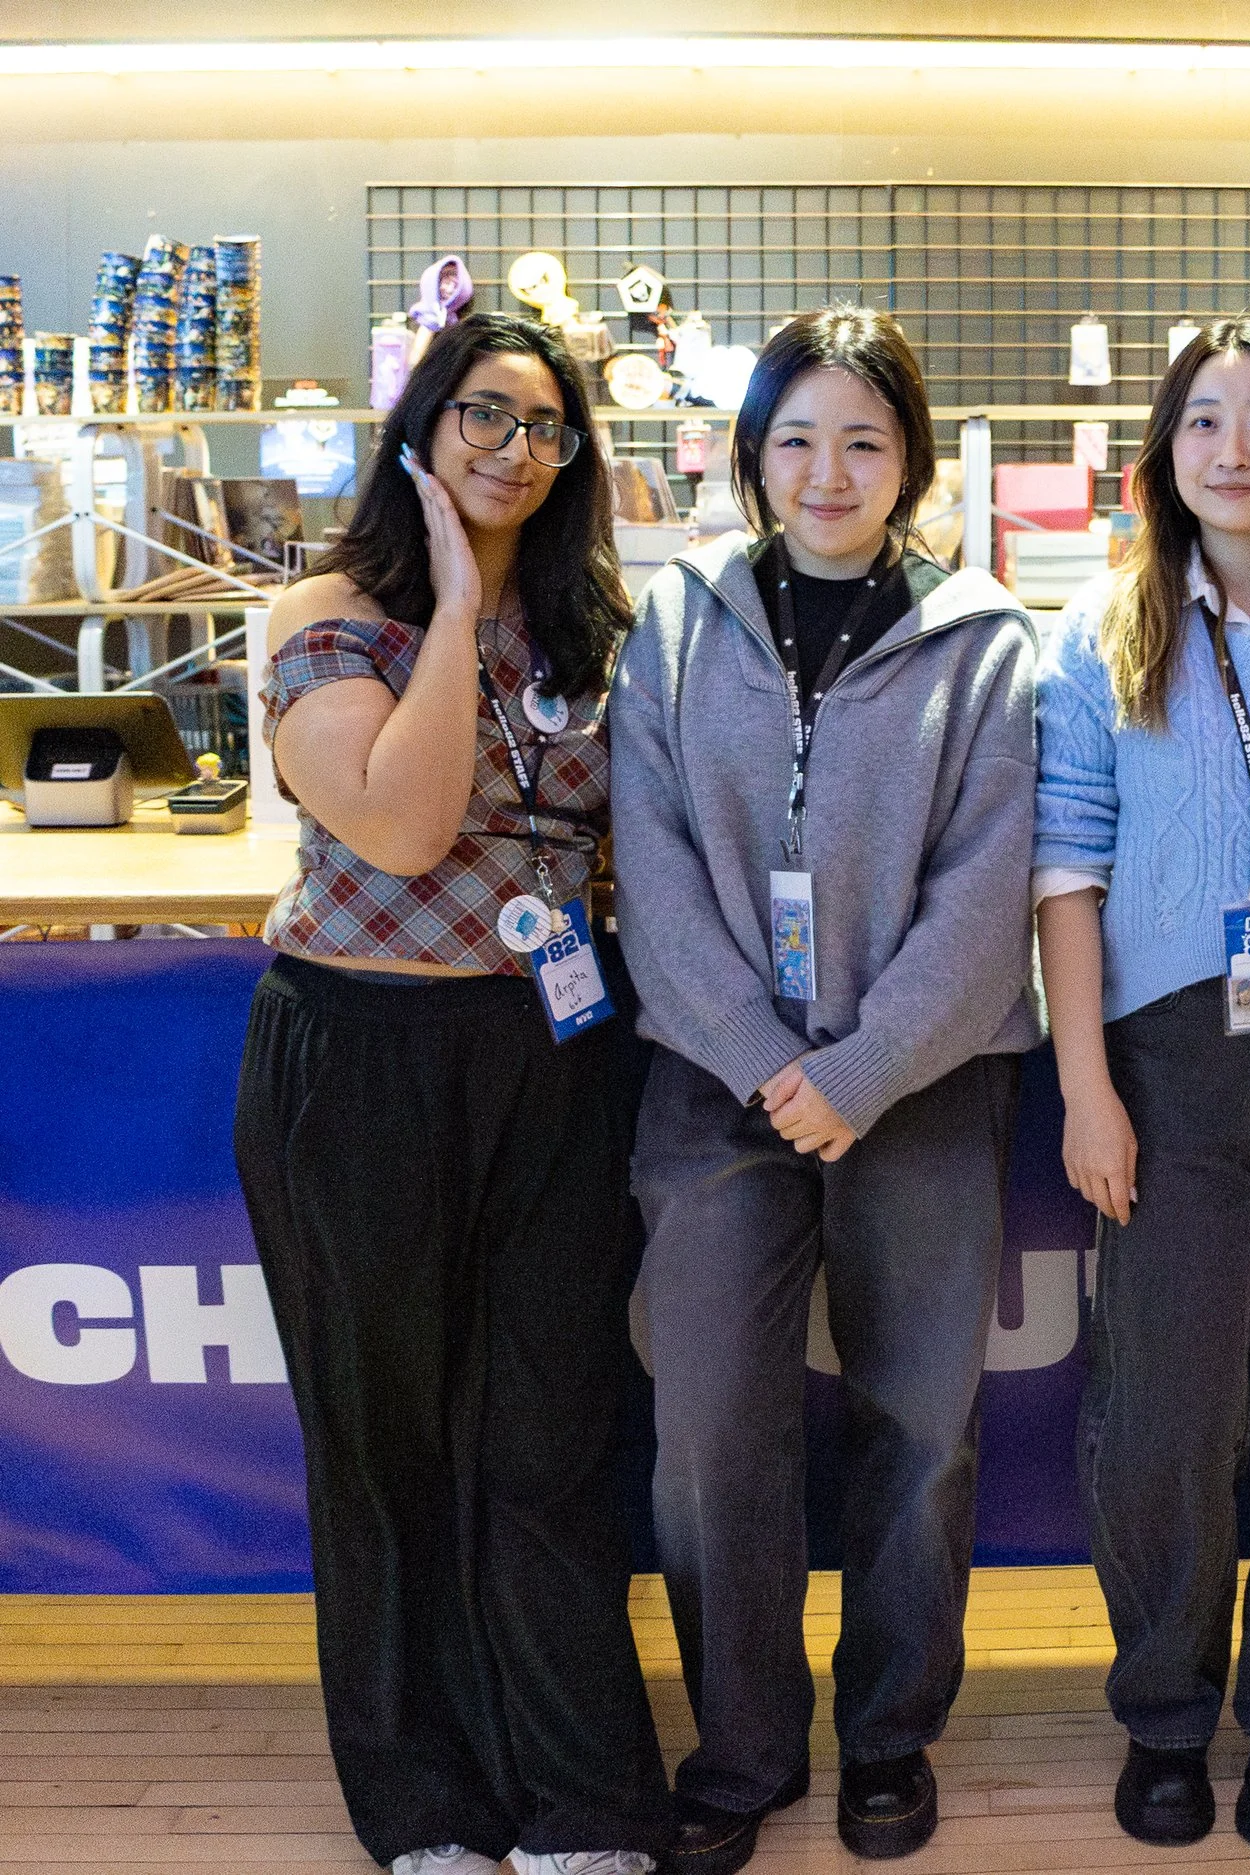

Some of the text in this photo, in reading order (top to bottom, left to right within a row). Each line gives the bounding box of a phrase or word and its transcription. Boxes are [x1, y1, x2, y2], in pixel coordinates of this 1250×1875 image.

[787, 670, 800, 716] hello82
[490, 698, 530, 789] hello82 STAFF
[547, 934, 580, 963] 82
